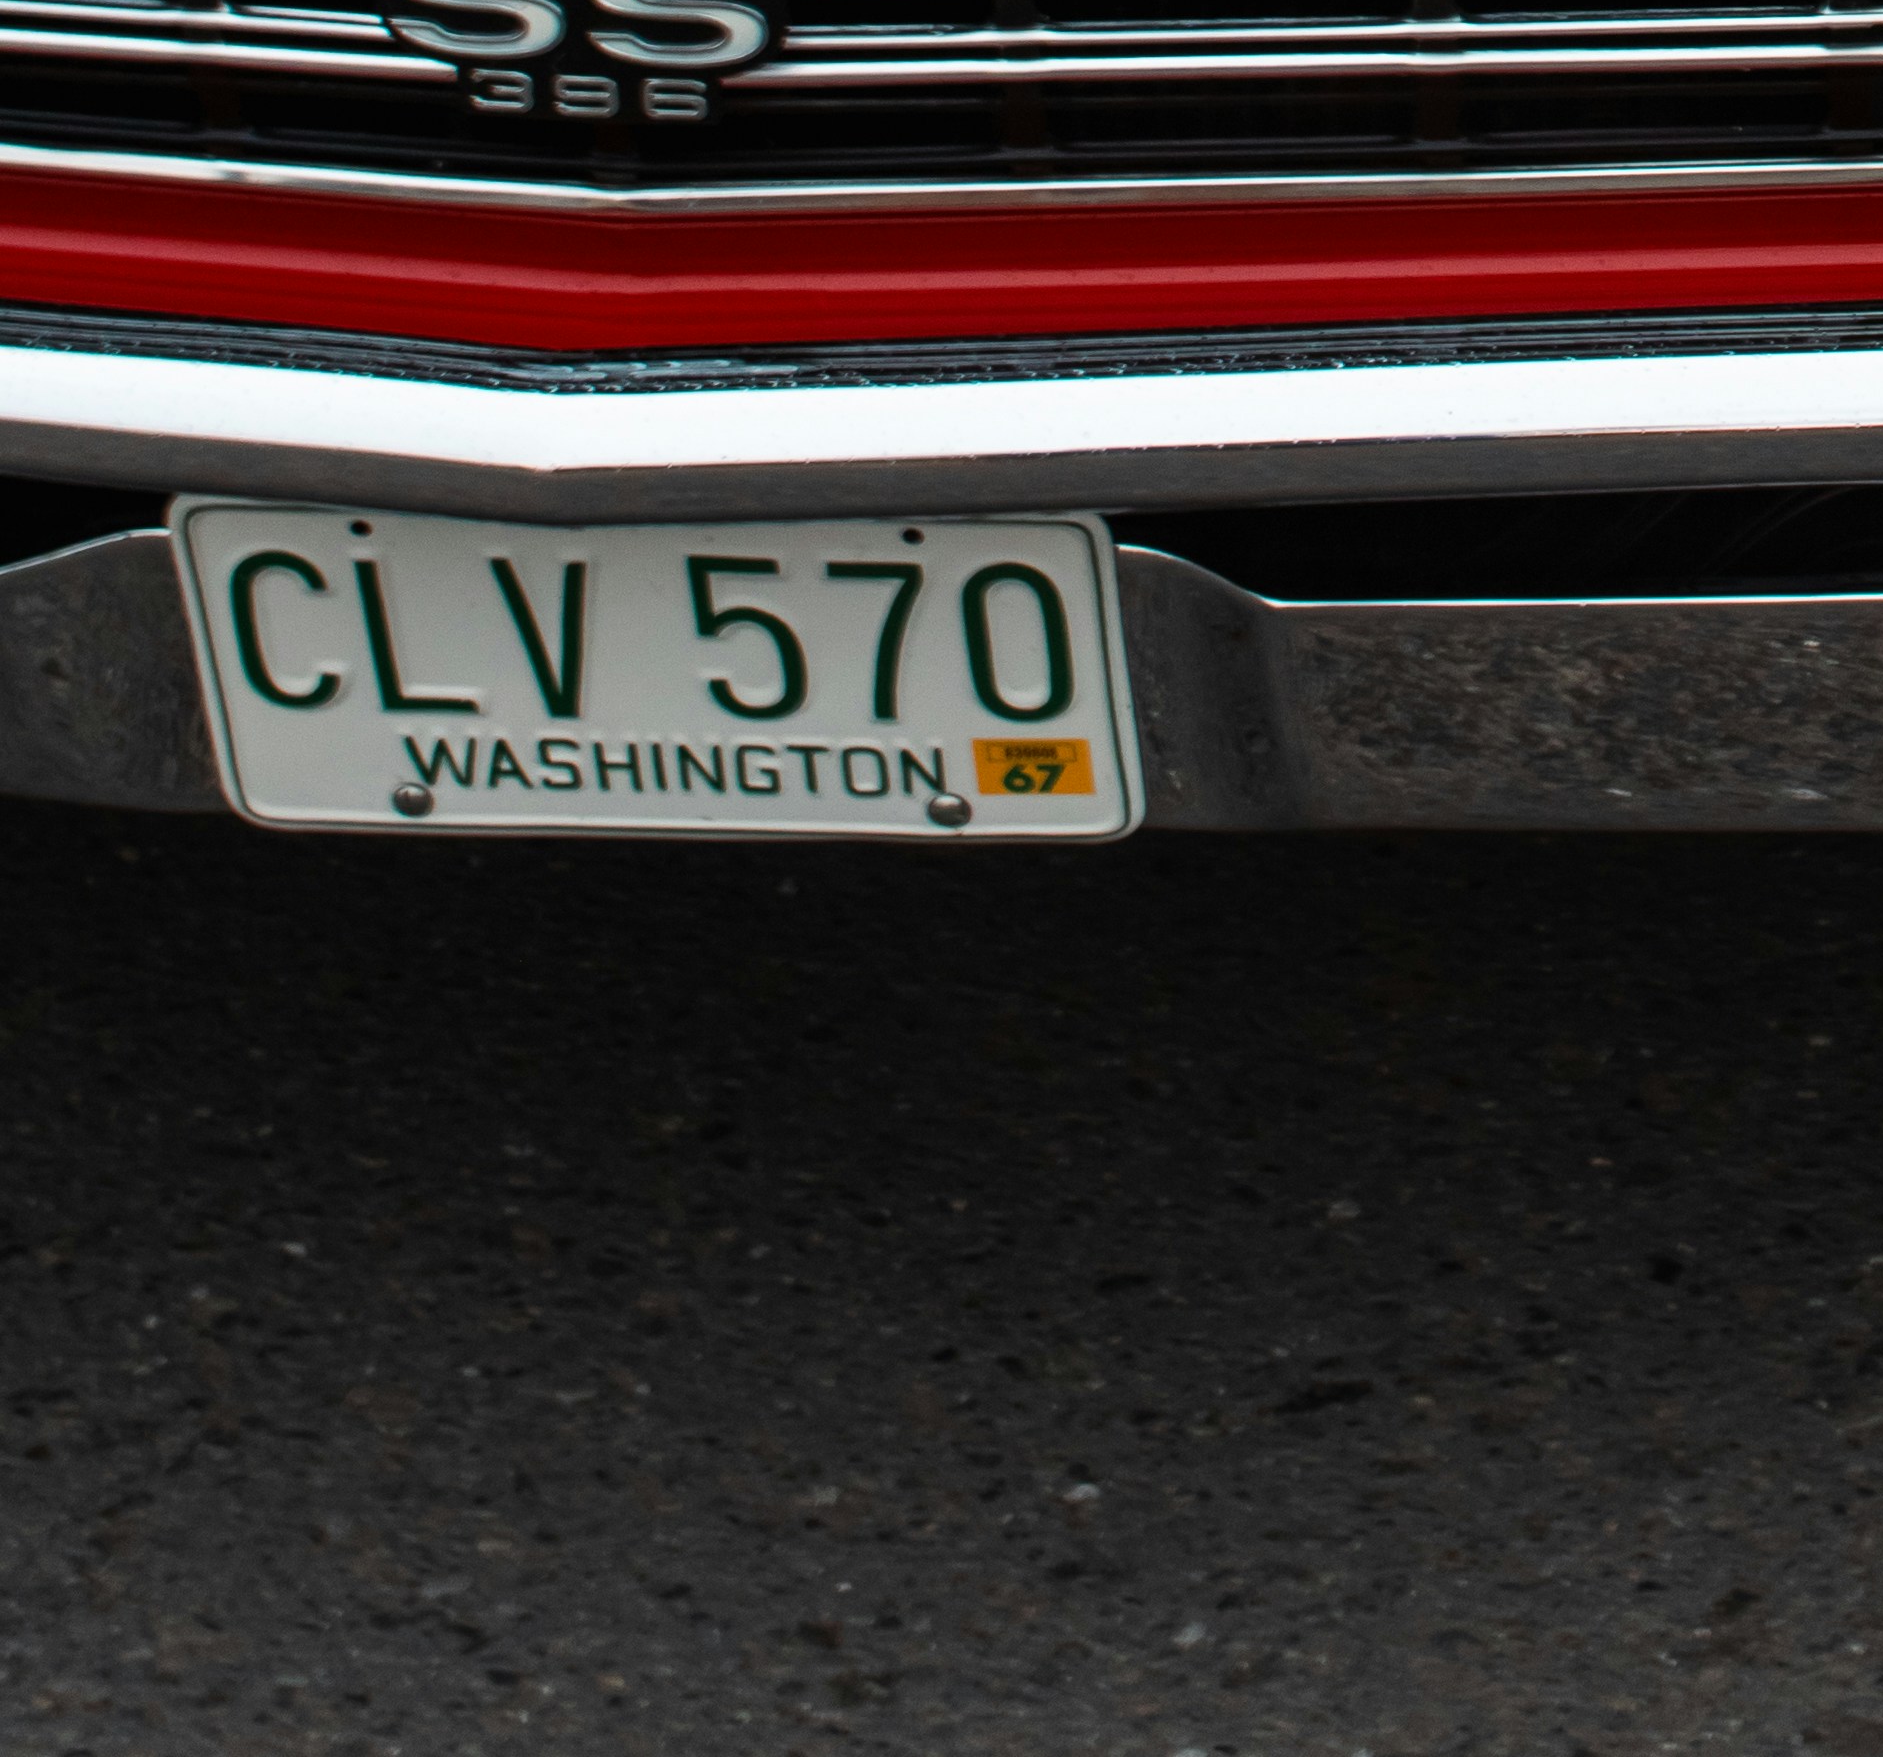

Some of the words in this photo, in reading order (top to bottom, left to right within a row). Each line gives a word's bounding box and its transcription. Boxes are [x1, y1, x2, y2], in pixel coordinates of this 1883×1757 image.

[469, 69, 709, 121] 396
[230, 550, 586, 718] CLV
[686, 554, 1075, 722] 570
[403, 735, 947, 795] WASHINGTON
[1003, 764, 1065, 794] 67
